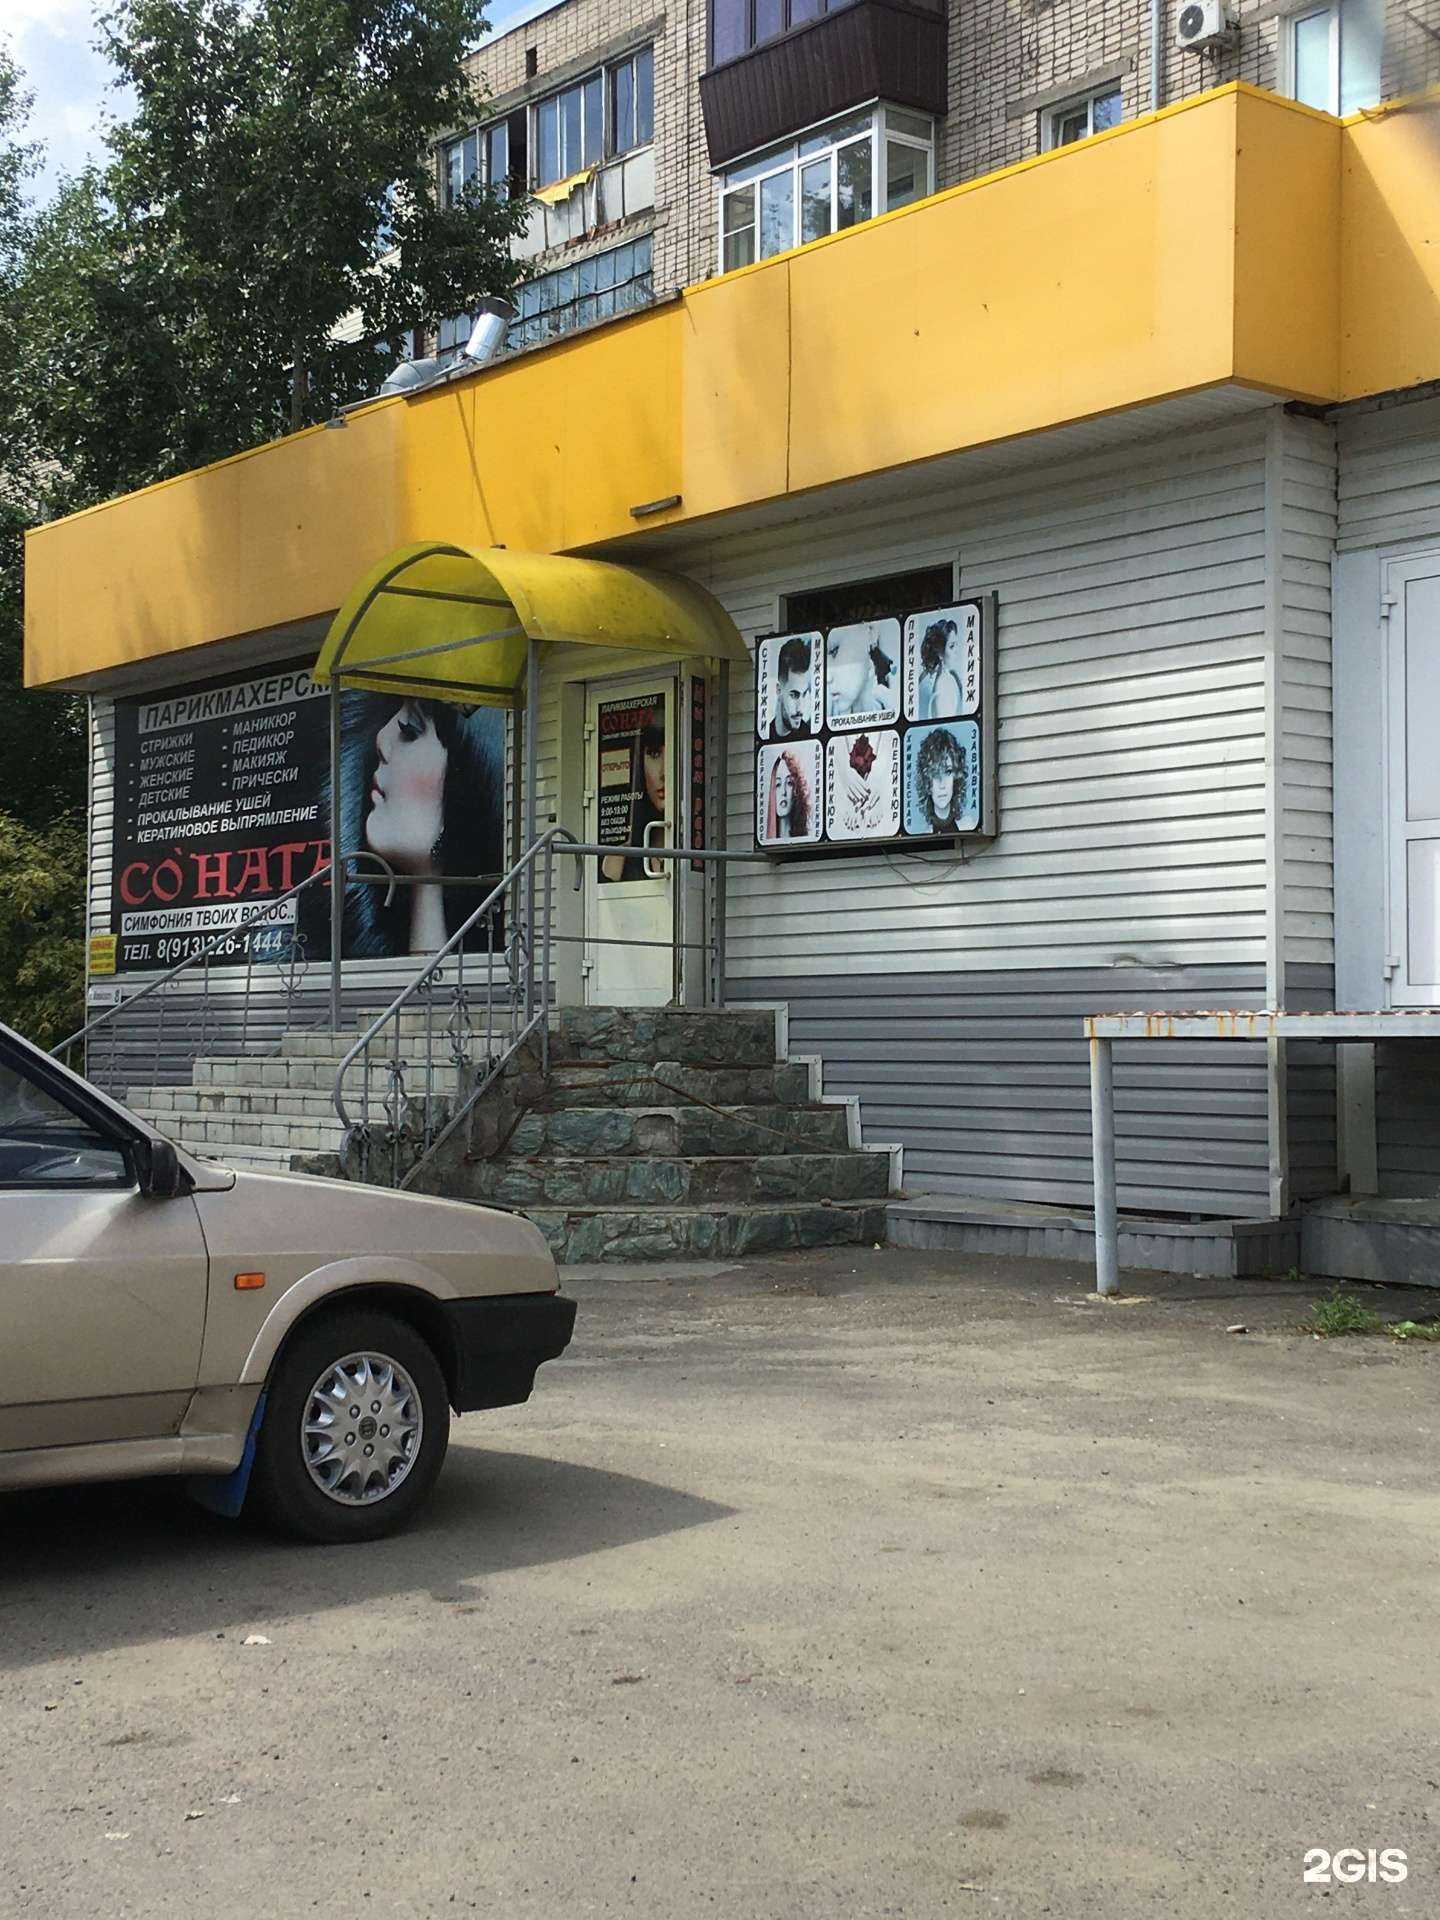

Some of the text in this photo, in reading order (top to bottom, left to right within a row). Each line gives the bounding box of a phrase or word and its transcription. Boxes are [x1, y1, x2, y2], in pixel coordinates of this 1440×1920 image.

[966, 615, 976, 703] МАКИЯЖ
[760, 648, 768, 731] СТРИЖКИ
[233, 711, 297, 736] МАНИКЮР
[831, 713, 878, 727] ПРОКАЛЫВАНИЕ
[140, 732, 193, 754] СТРИЖКИ
[232, 730, 295, 754] ПЕДИКЮР
[139, 750, 195, 771] МУЖСКИЕ
[232, 750, 287, 773] МАКИЯЖ
[139, 768, 194, 789] ЖЕНСКИЕ
[232, 767, 299, 791] ПРИЧЕСКИ
[827, 746, 836, 829] МАНИКЮР
[891, 737, 899, 821] ПЕДИКЮР
[138, 786, 191, 808] ДЕТСКИЕ
[137, 793, 271, 826] ПРОКАЛЫВАНИЕ УШЕЙ
[137, 805, 318, 844] КЕРАТИНОВОЕ ВЫПРЯМЛЕНИЕ
[124, 911, 193, 932] СИМФОНИЯ
[196, 907, 238, 926] ТВОИХ
[123, 944, 151, 960] ТЕЛ.
